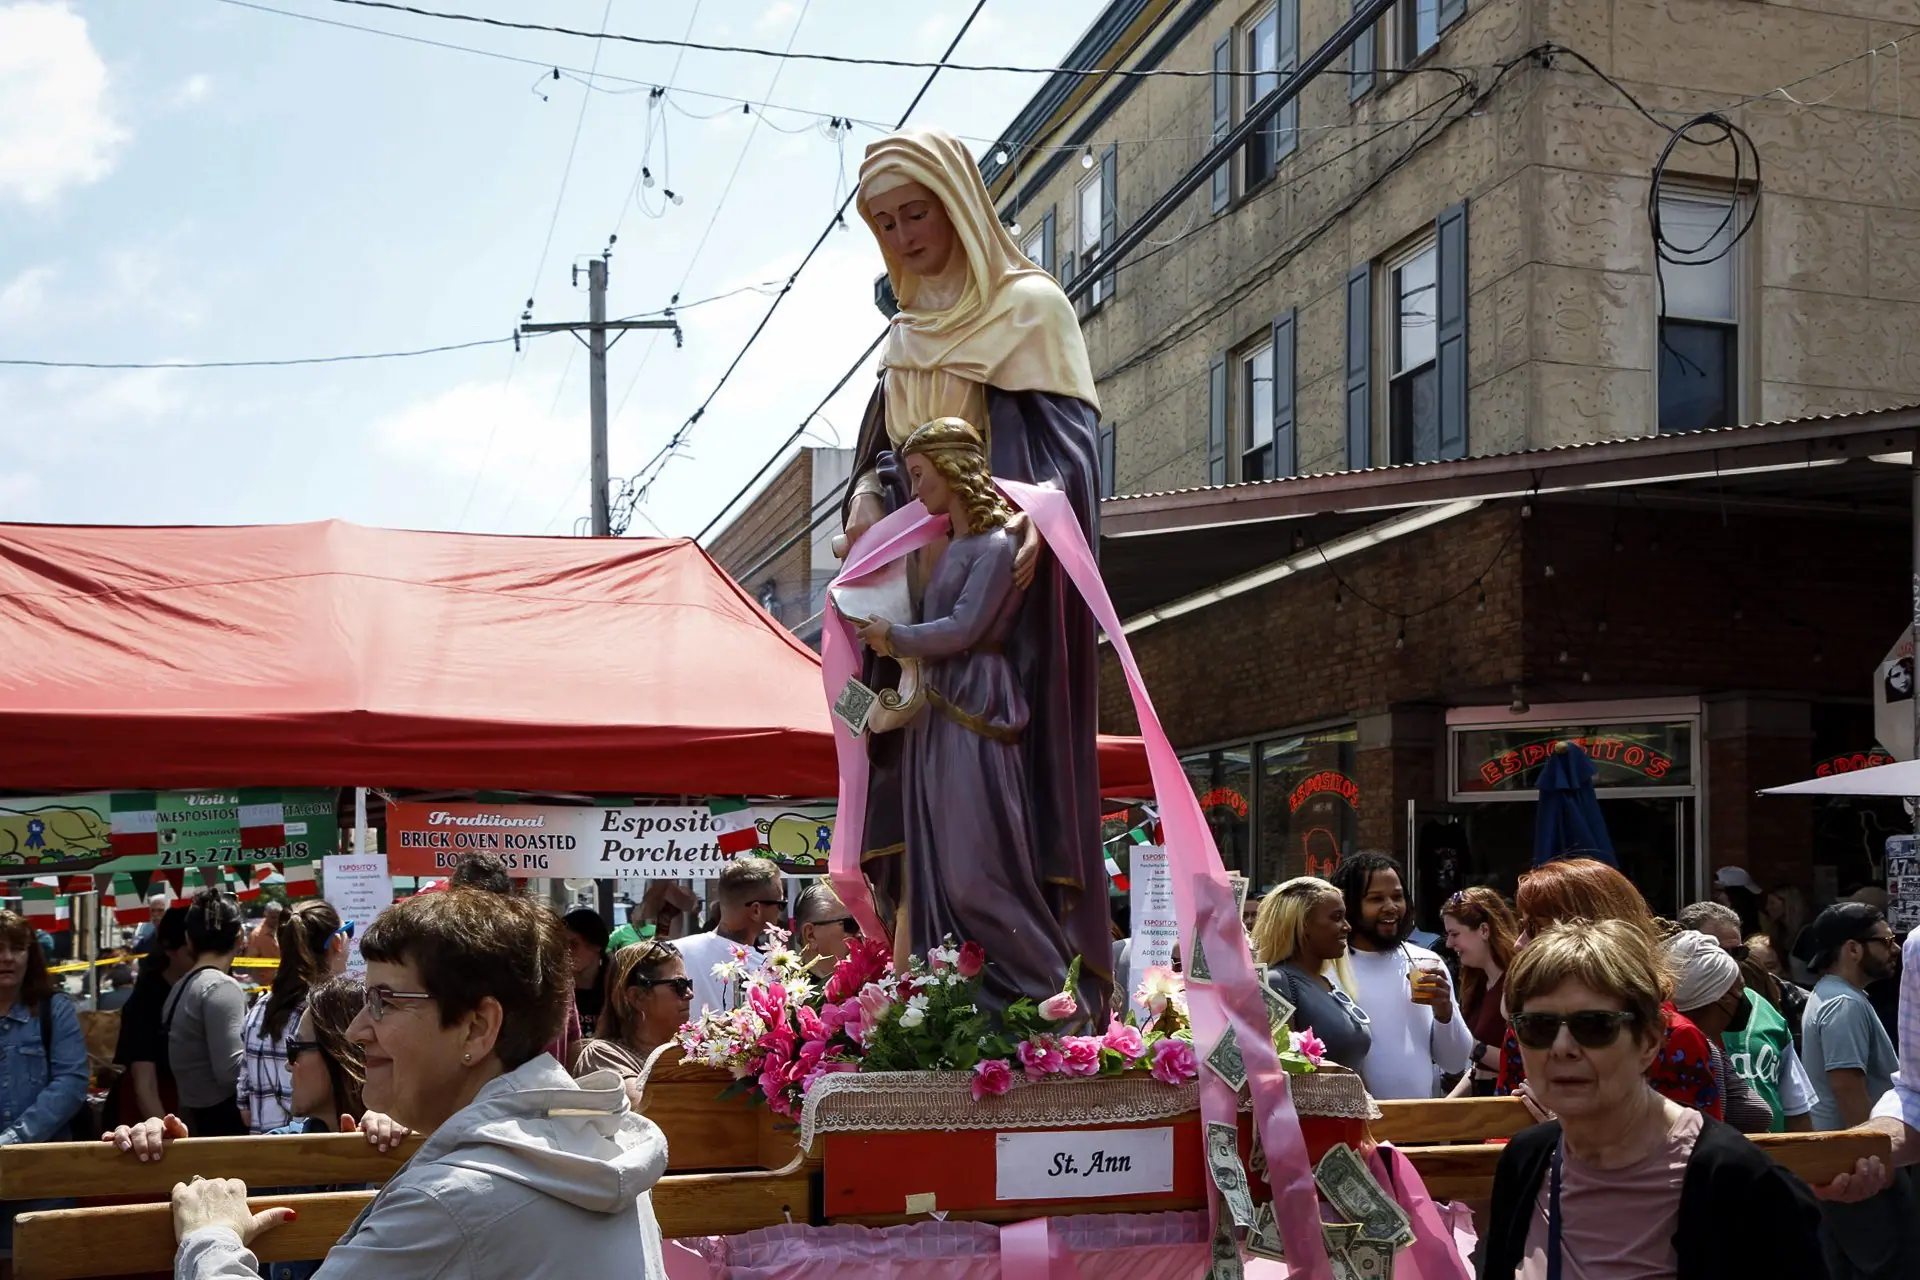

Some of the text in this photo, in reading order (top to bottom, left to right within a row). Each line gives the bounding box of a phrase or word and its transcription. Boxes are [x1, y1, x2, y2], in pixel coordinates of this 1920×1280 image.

[1480, 736, 1672, 785] ESPSITO'S
[184, 793, 225, 806] Visit
[1289, 770, 1359, 813] ESPOSITO'S
[428, 811, 545, 828] Traditional
[400, 831, 577, 851] BRICK OVEN ROASTED
[160, 842, 309, 866] 215-271-8418
[436, 852, 549, 870] BOSS PIG
[615, 868, 678, 877] ITALIAN
[1047, 1149, 1132, 1177] St. Ann
